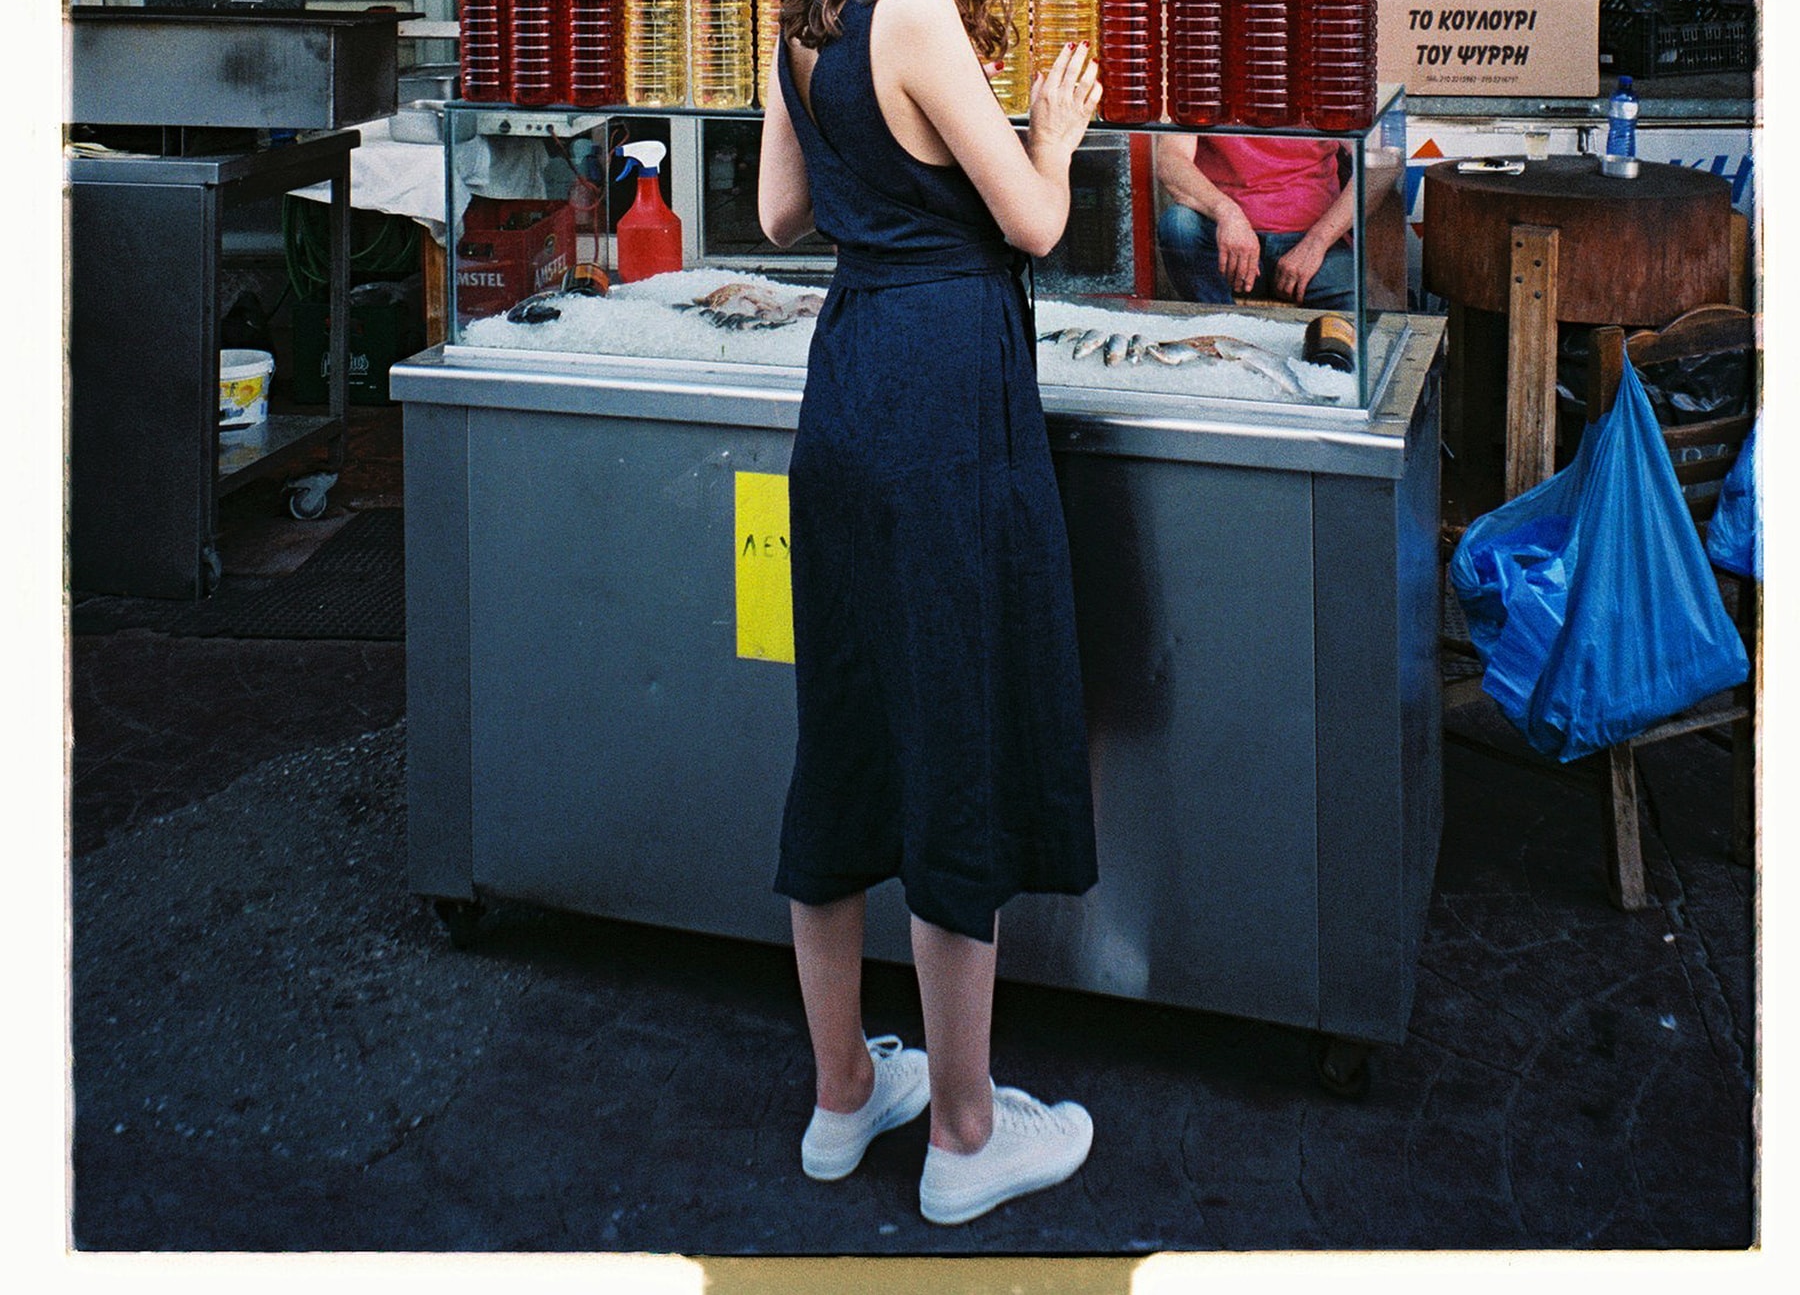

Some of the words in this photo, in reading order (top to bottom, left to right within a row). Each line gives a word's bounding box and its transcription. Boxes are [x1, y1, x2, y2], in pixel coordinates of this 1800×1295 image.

[1409, 10, 1434, 31] ΤΟ
[1438, 9, 1537, 32] ΚΟΥΛΟΥΡΙ
[1416, 45, 1453, 66] ΤΟΥ
[1457, 44, 1530, 66] ΨΥΡΡΗ
[456, 272, 505, 287] MSTEL
[534, 253, 569, 288] AMSTEL
